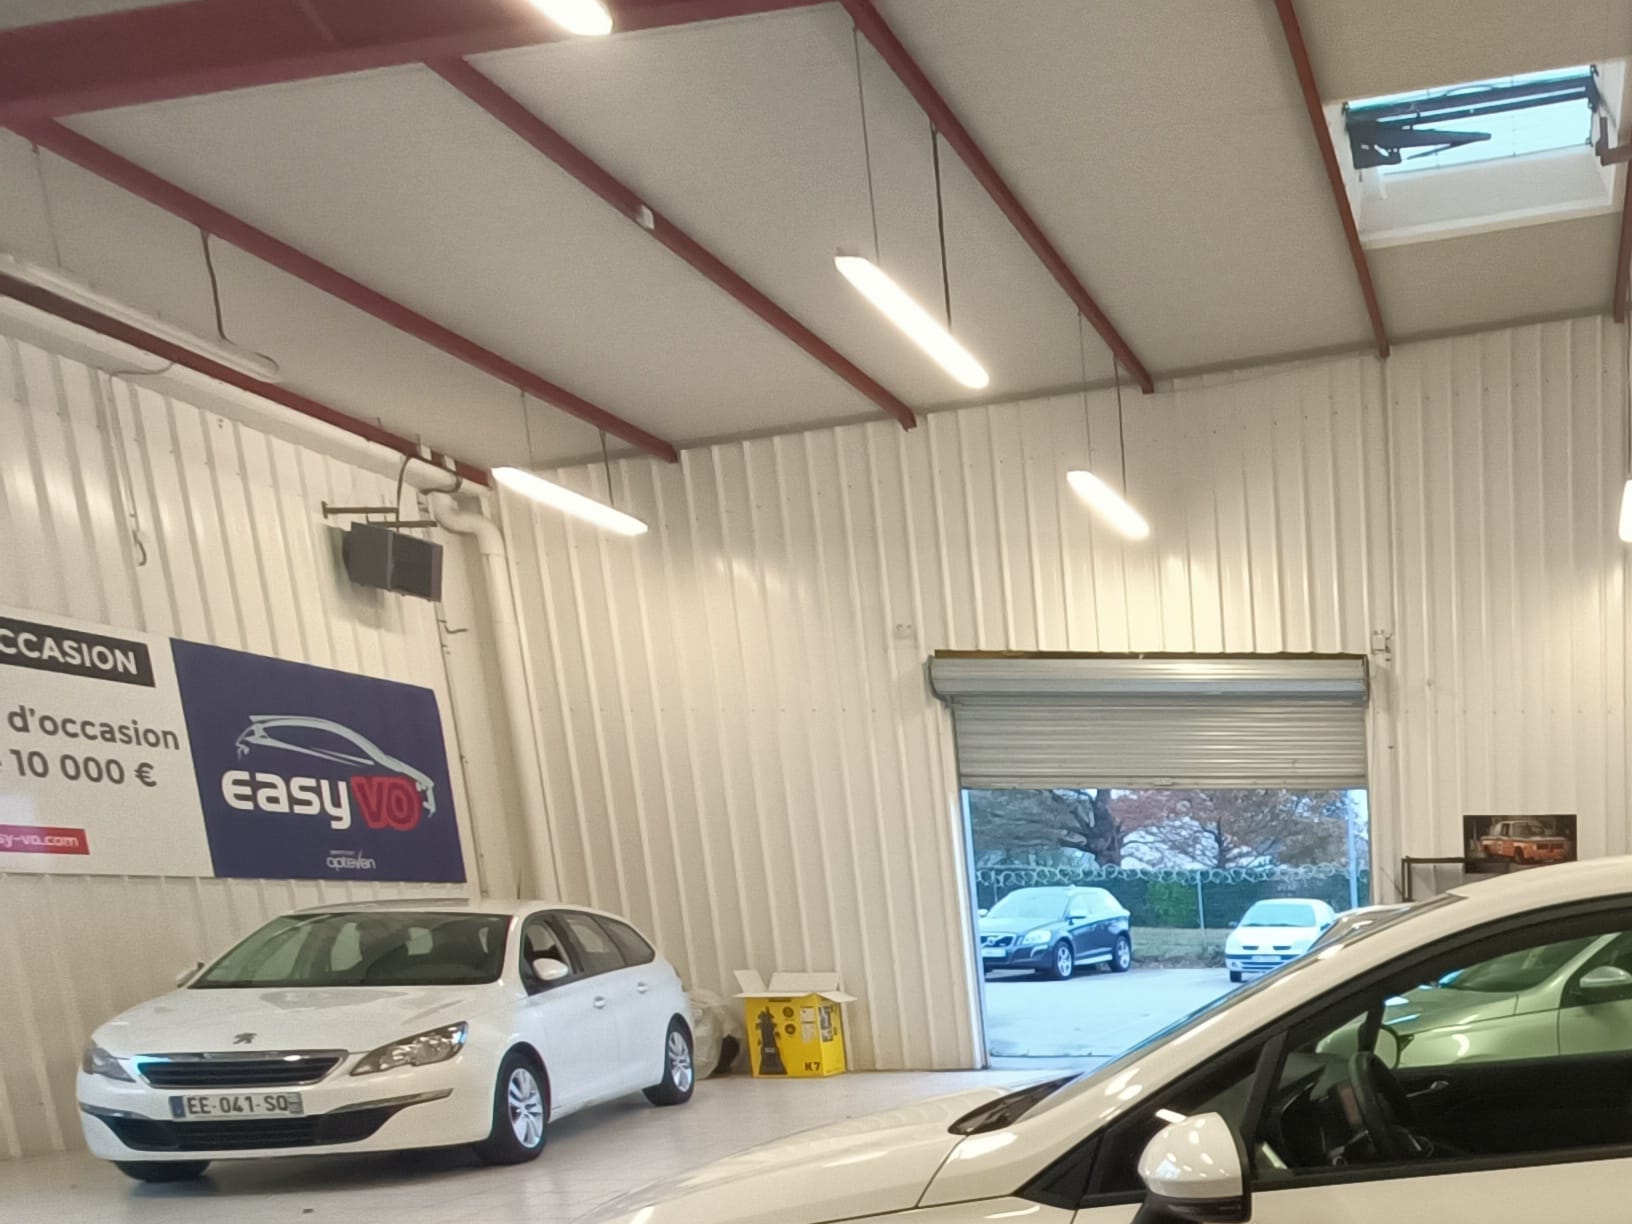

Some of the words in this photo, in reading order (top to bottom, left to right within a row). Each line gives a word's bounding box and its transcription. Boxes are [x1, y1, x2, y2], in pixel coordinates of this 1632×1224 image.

[7, 704, 180, 750] d'occasion
[9, 748, 49, 778] 10
[60, 753, 125, 785] 000
[134, 762, 157, 787] €
